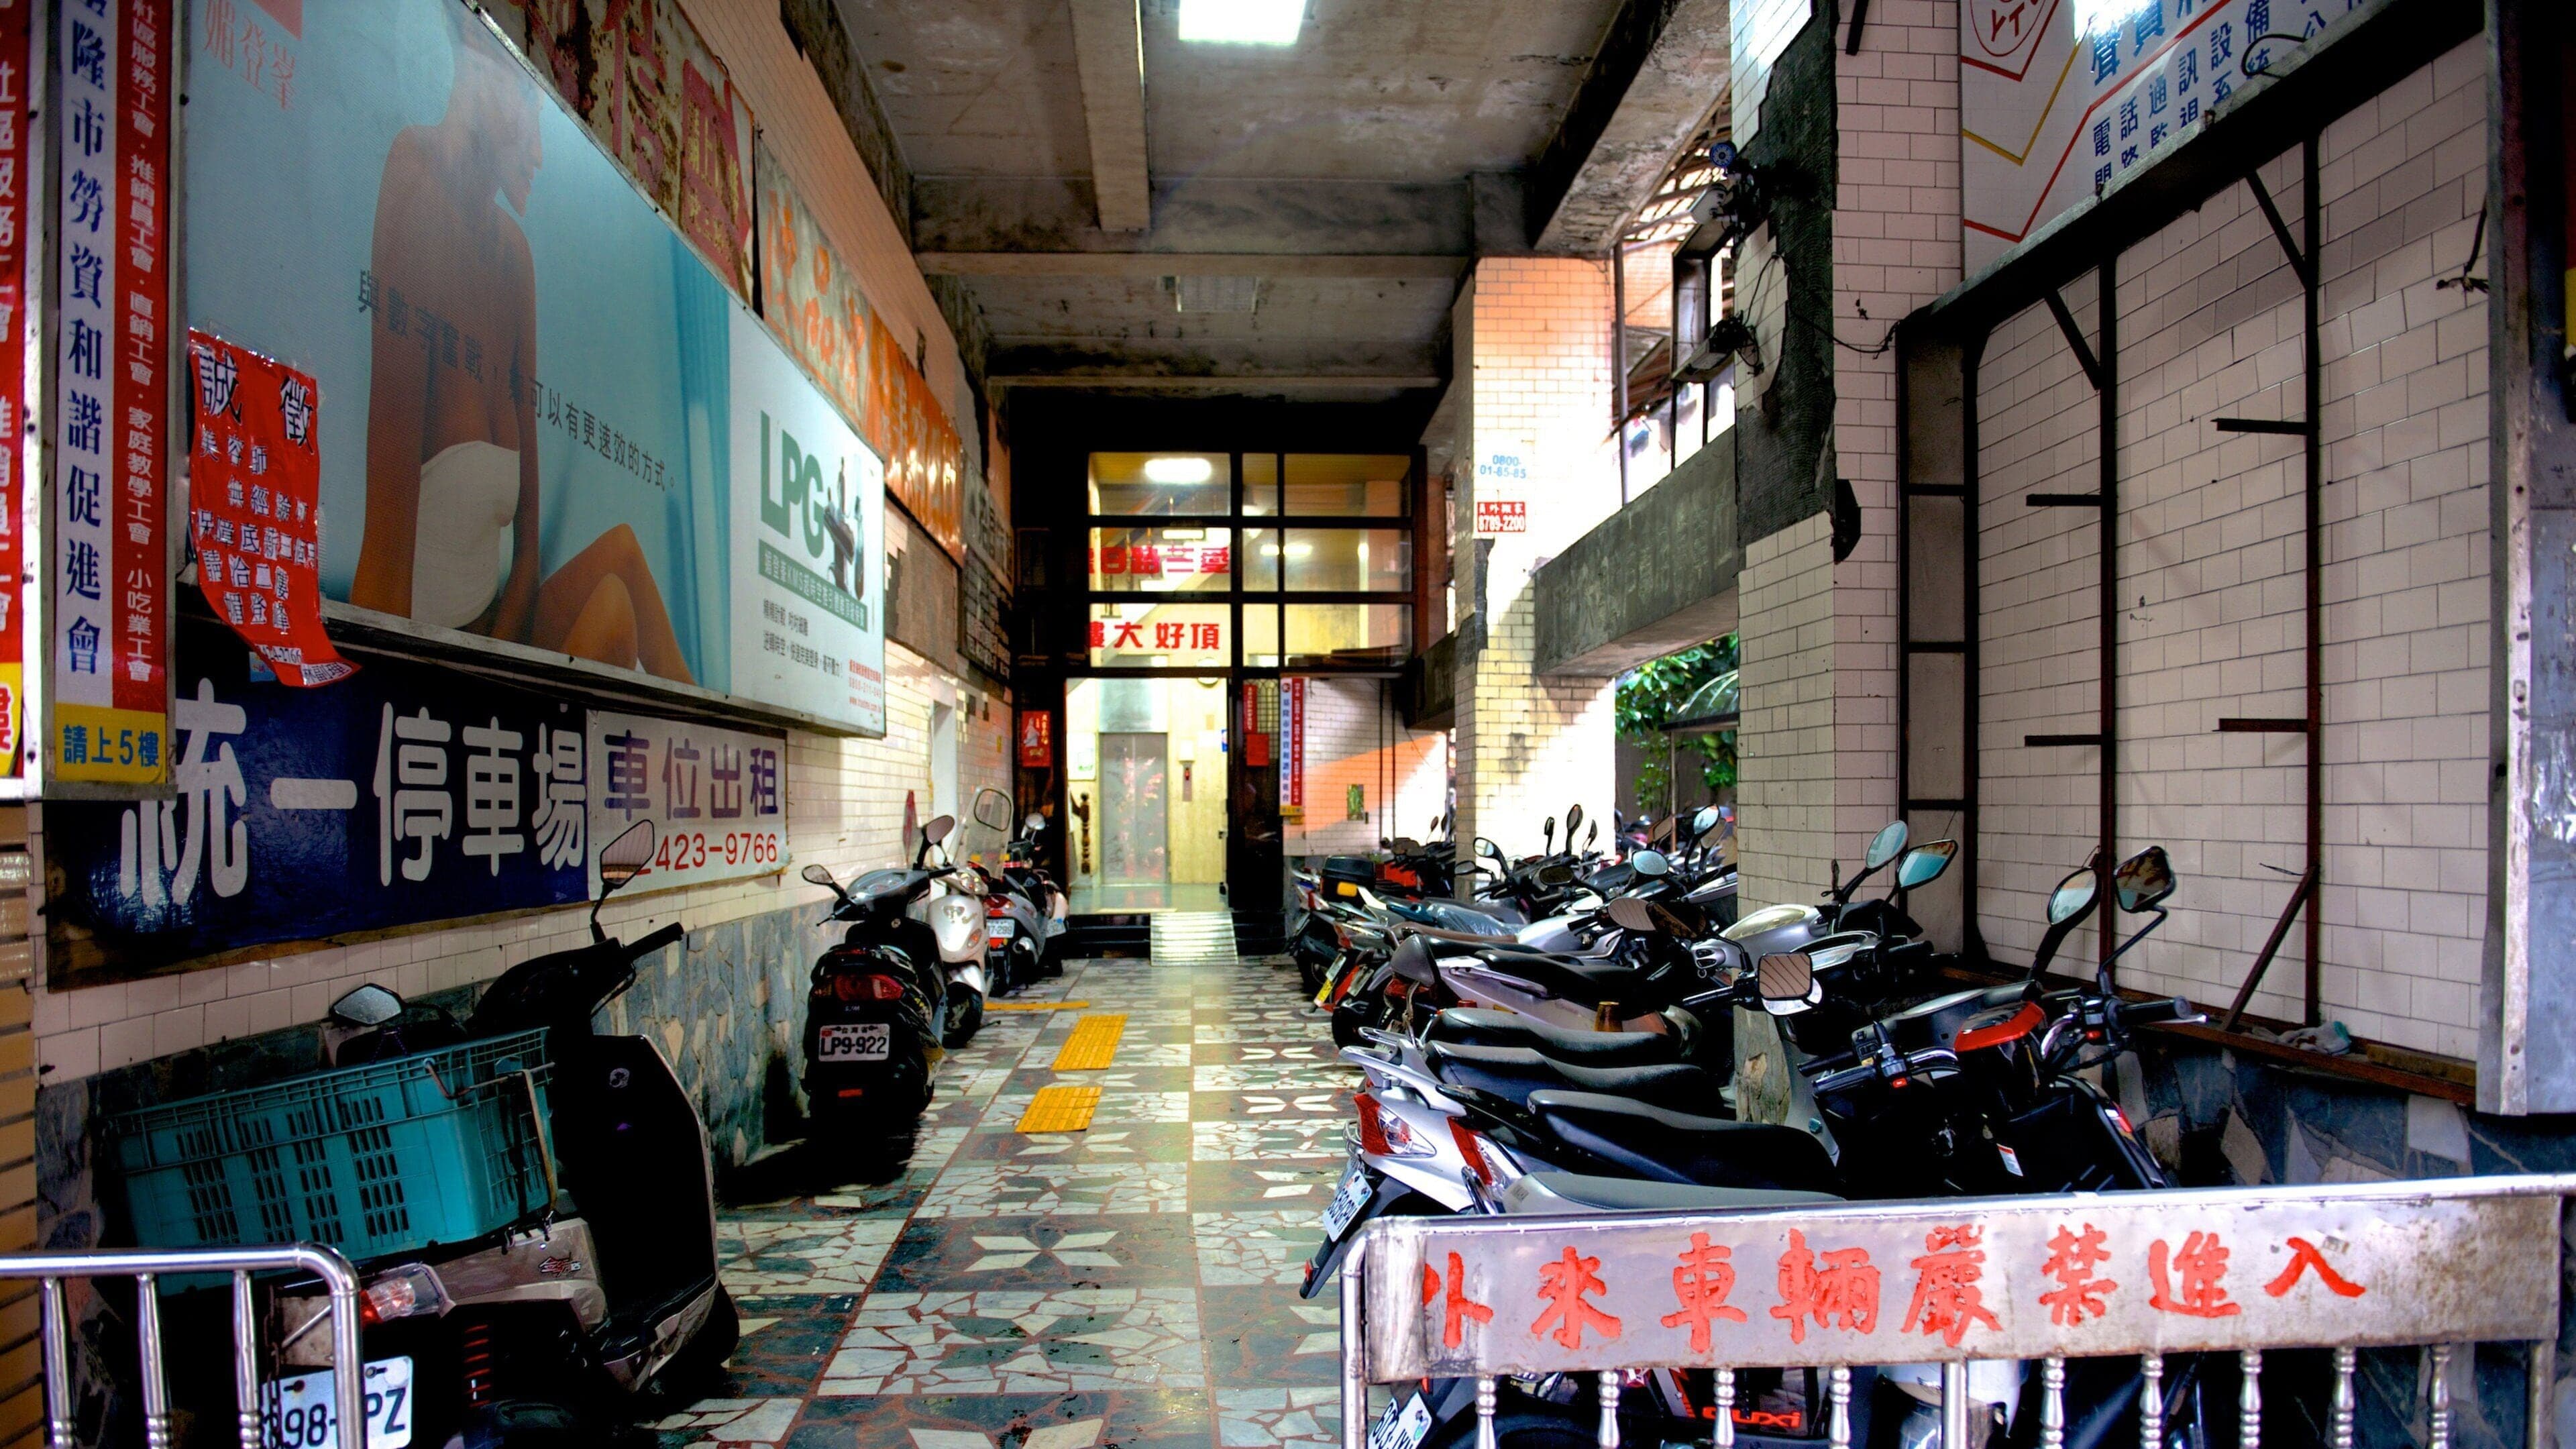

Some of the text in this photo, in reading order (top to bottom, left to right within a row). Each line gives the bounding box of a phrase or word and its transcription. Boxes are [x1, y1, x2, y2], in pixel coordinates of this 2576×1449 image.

[200, 429, 268, 475] 美容師
[761, 410, 824, 559] LPG
[63, 724, 160, 768] 請上5樓
[604, 729, 778, 821] 車位出租
[635, 833, 777, 876] 423-9766
[820, 1036, 886, 1056] LP9-922
